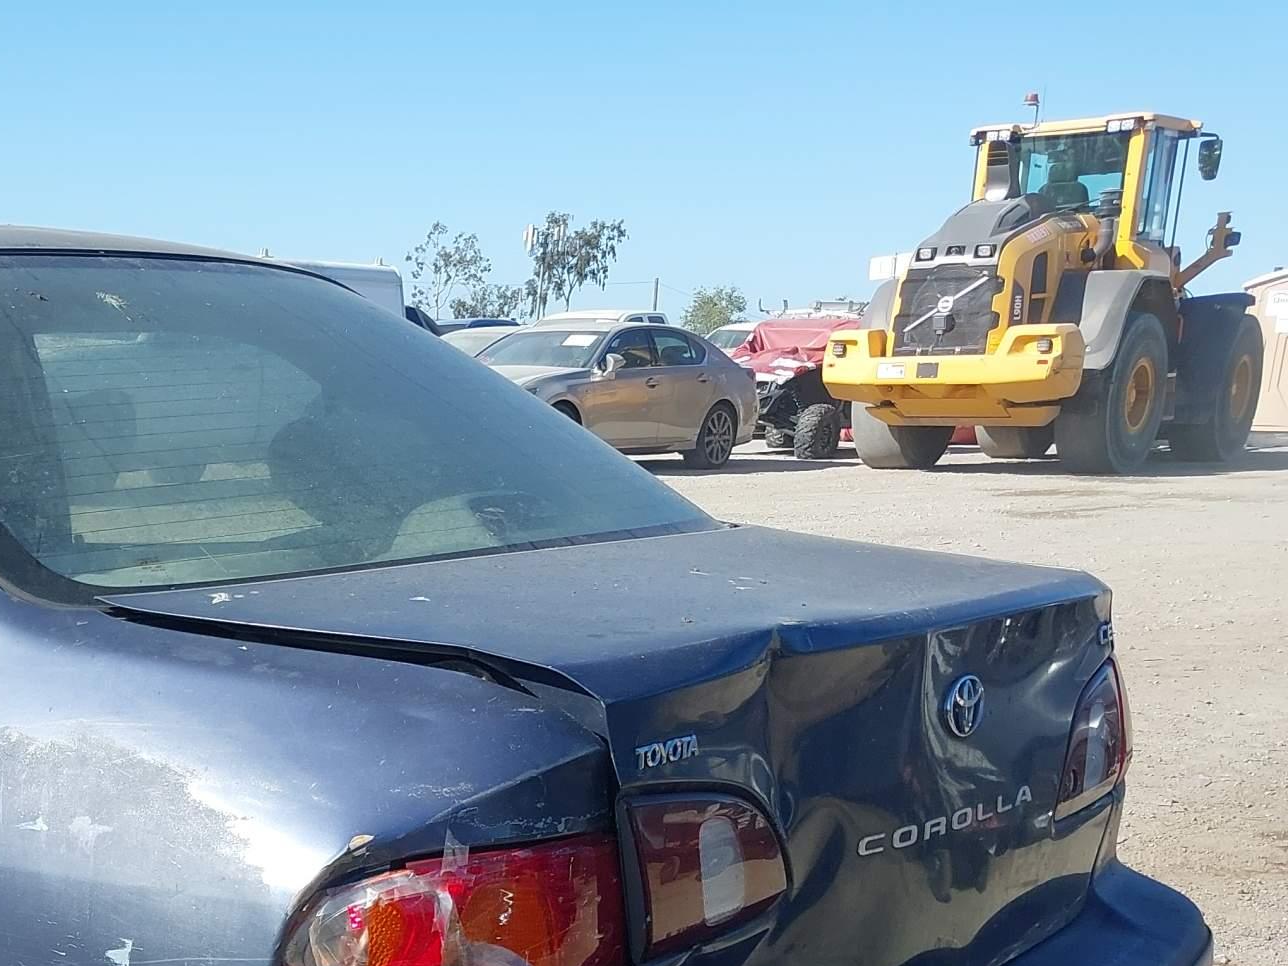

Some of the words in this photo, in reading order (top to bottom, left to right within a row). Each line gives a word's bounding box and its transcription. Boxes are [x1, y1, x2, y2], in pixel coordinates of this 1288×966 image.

[1013, 295, 1023, 321] L90H
[635, 734, 699, 770] TOYOTA
[857, 785, 1033, 857] COROLLA
